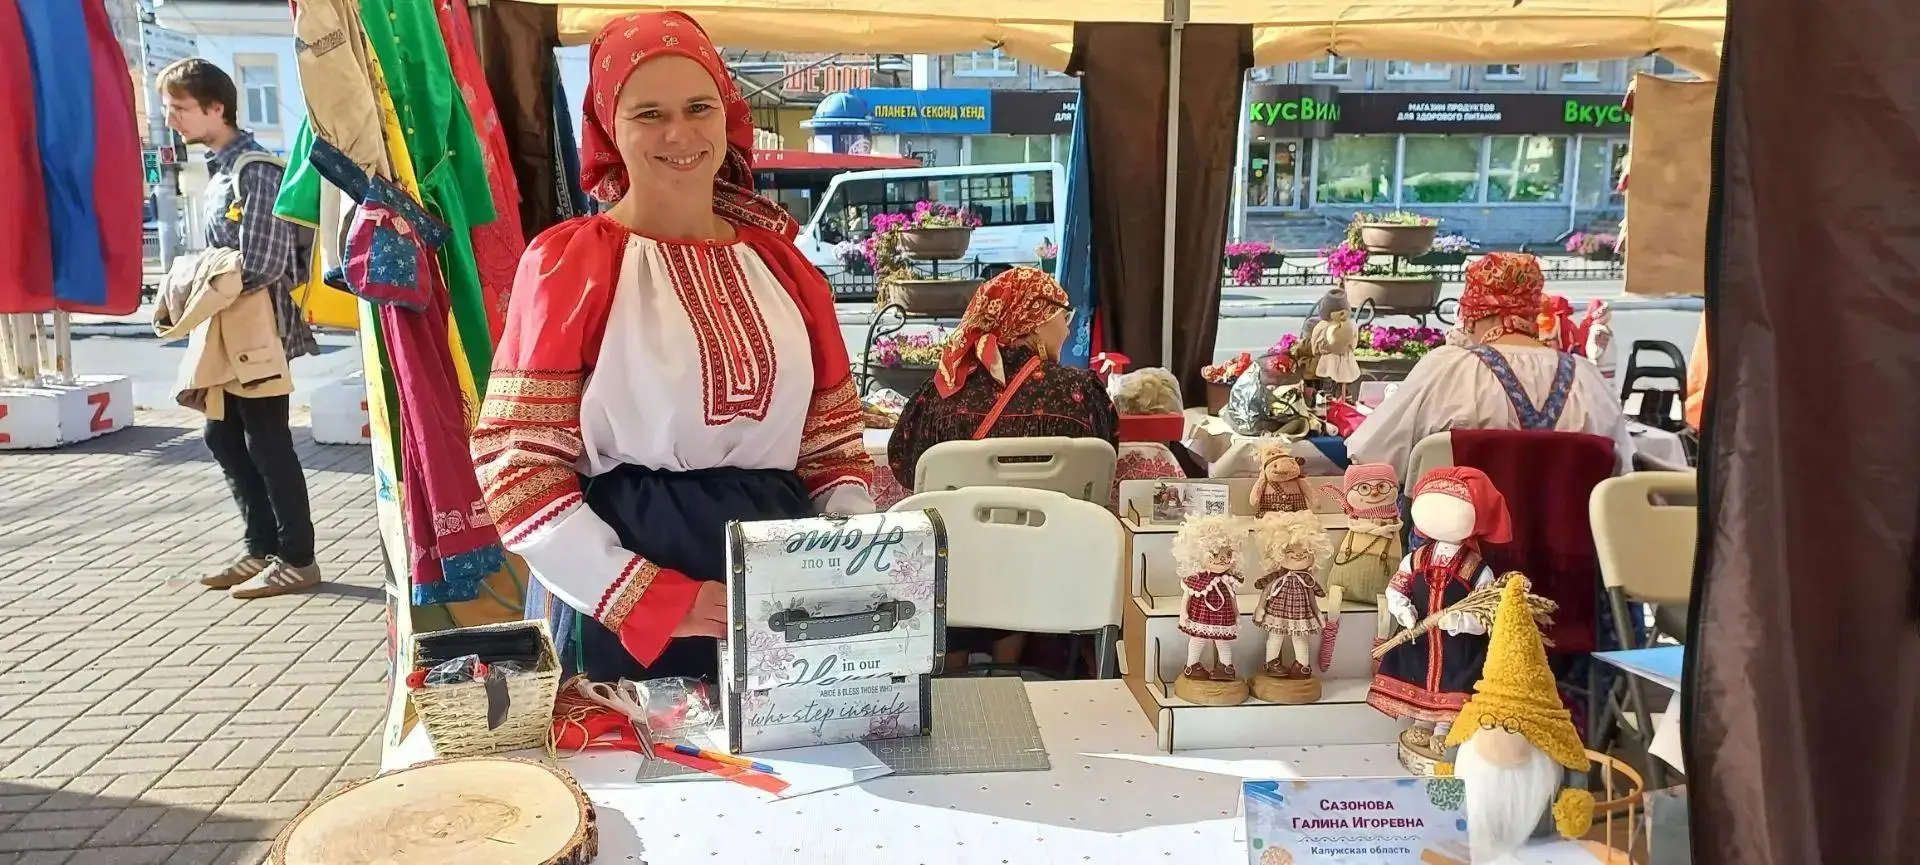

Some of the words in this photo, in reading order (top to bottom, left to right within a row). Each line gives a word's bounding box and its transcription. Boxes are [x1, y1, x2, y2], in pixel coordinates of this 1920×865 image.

[875, 105, 917, 118] ПЛАНЕТА
[920, 105, 958, 120] СЕКОНД
[960, 105, 985, 120] ХЕНД
[1408, 102, 1446, 112] МАГАЗИН
[1447, 102, 1495, 112] ПРОДУКТОВ
[1054, 112, 1072, 122] ДЛЯ
[1396, 112, 1414, 121] ДЛЯ
[1416, 112, 1463, 121] ЗДОРОВОГО
[1464, 112, 1502, 121] ПИТАНИЯ
[87, 391, 113, 432] Z
[785, 515, 904, 576] Home
[801, 558, 823, 569] our
[828, 557, 841, 571] in
[842, 659, 854, 672] in
[859, 659, 881, 671] our
[861, 686, 879, 696] THOSE
[751, 703, 789, 727] who
[792, 700, 835, 729] step
[839, 692, 909, 717] inside
[1320, 799, 1395, 811] САЗОНОВА
[1292, 817, 1349, 829] ГАЛИНА
[1352, 816, 1425, 829] ИГОРЕВНА
[1311, 846, 1367, 857] Калужская
[1369, 846, 1411, 855] область
